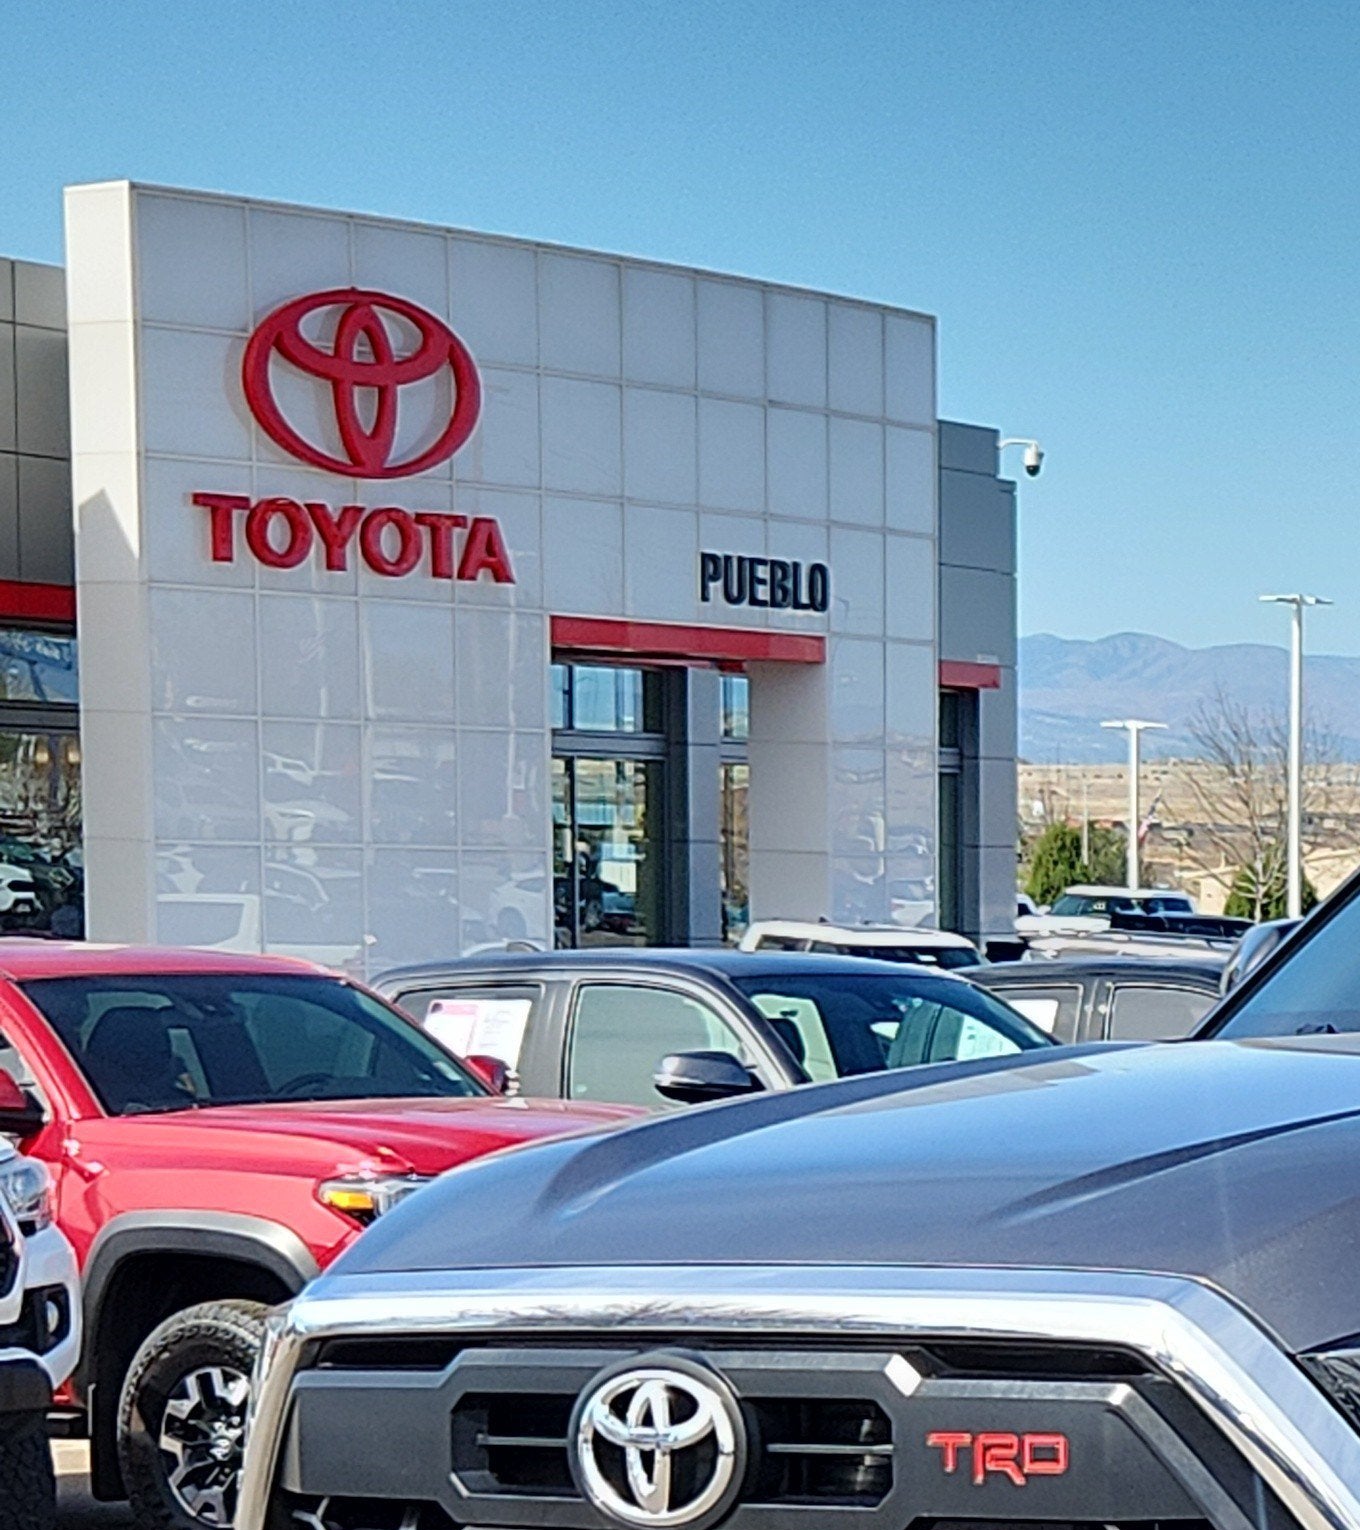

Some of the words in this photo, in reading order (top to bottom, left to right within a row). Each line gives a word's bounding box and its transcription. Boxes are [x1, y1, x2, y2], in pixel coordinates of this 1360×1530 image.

[192, 492, 516, 585] TOYOTA
[700, 551, 831, 613] PUEBLO
[926, 1430, 1070, 1487] TRD
